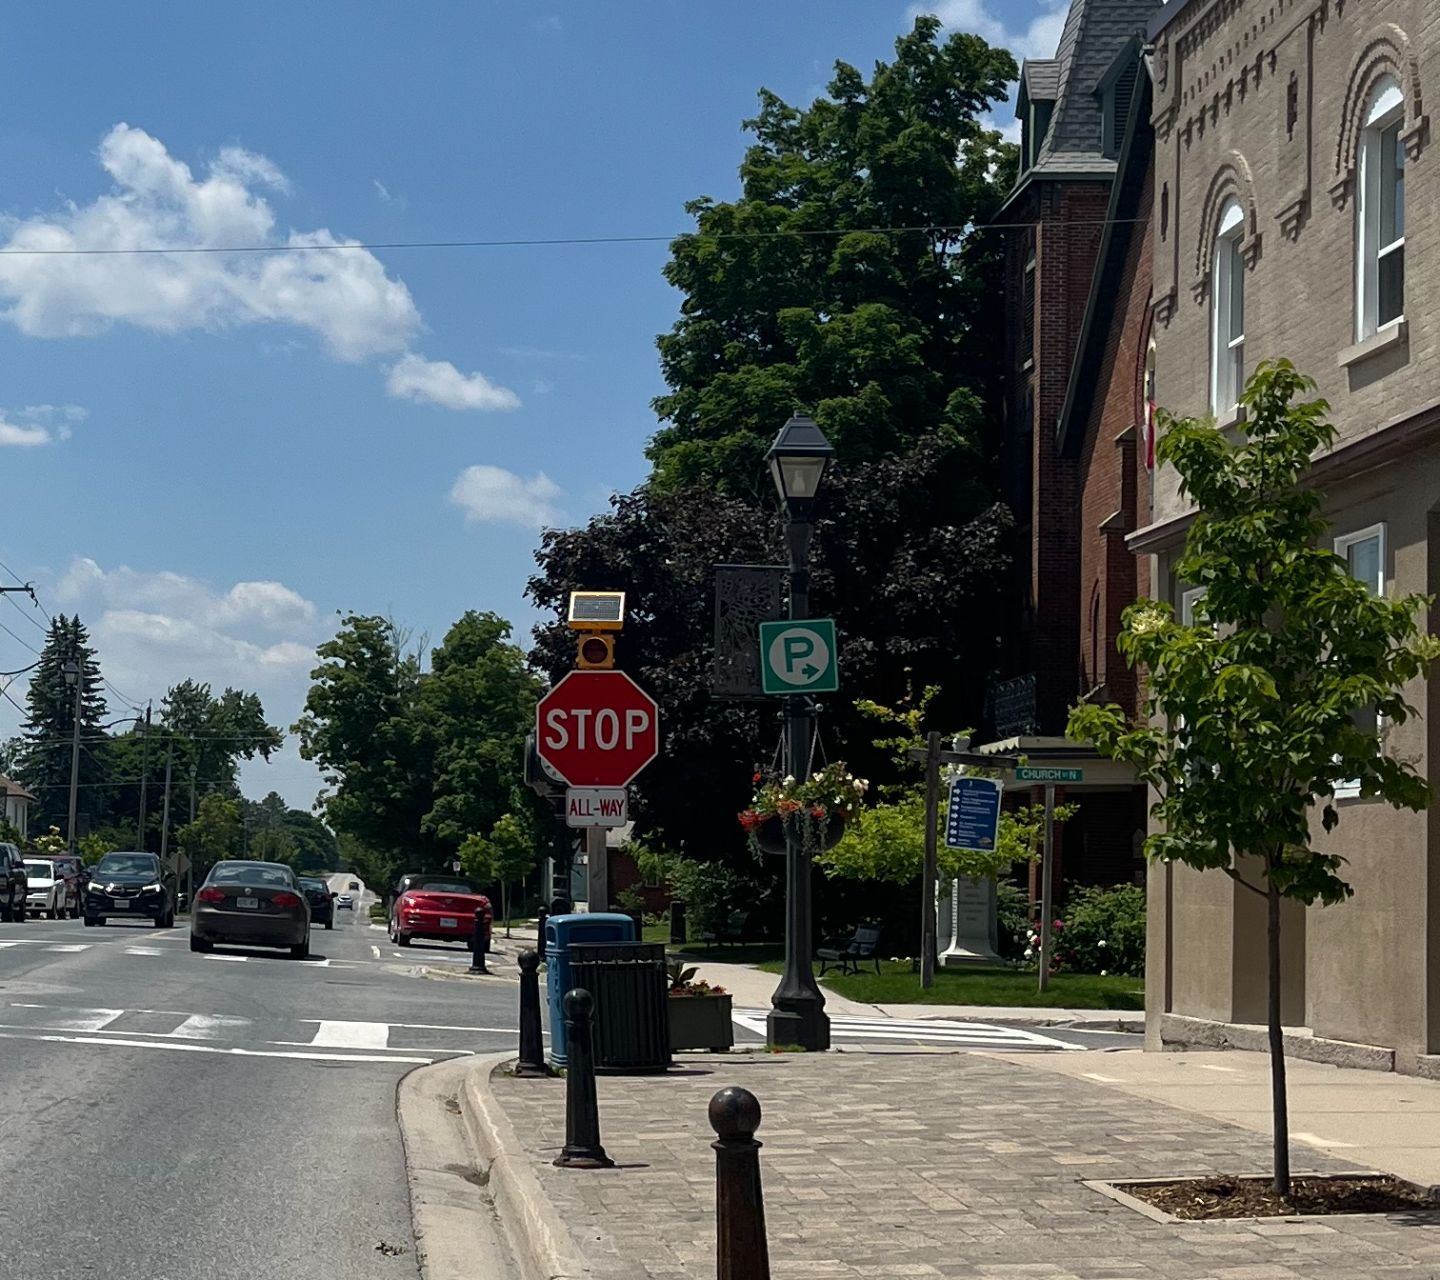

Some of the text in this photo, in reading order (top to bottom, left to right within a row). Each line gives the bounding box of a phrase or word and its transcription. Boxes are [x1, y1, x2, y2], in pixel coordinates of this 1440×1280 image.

[783, 636, 814, 673] P
[545, 708, 650, 751] STOP
[1022, 769, 1062, 779] CHURCH
[1069, 770, 1077, 780] N
[569, 799, 625, 817] ALL-WAY
